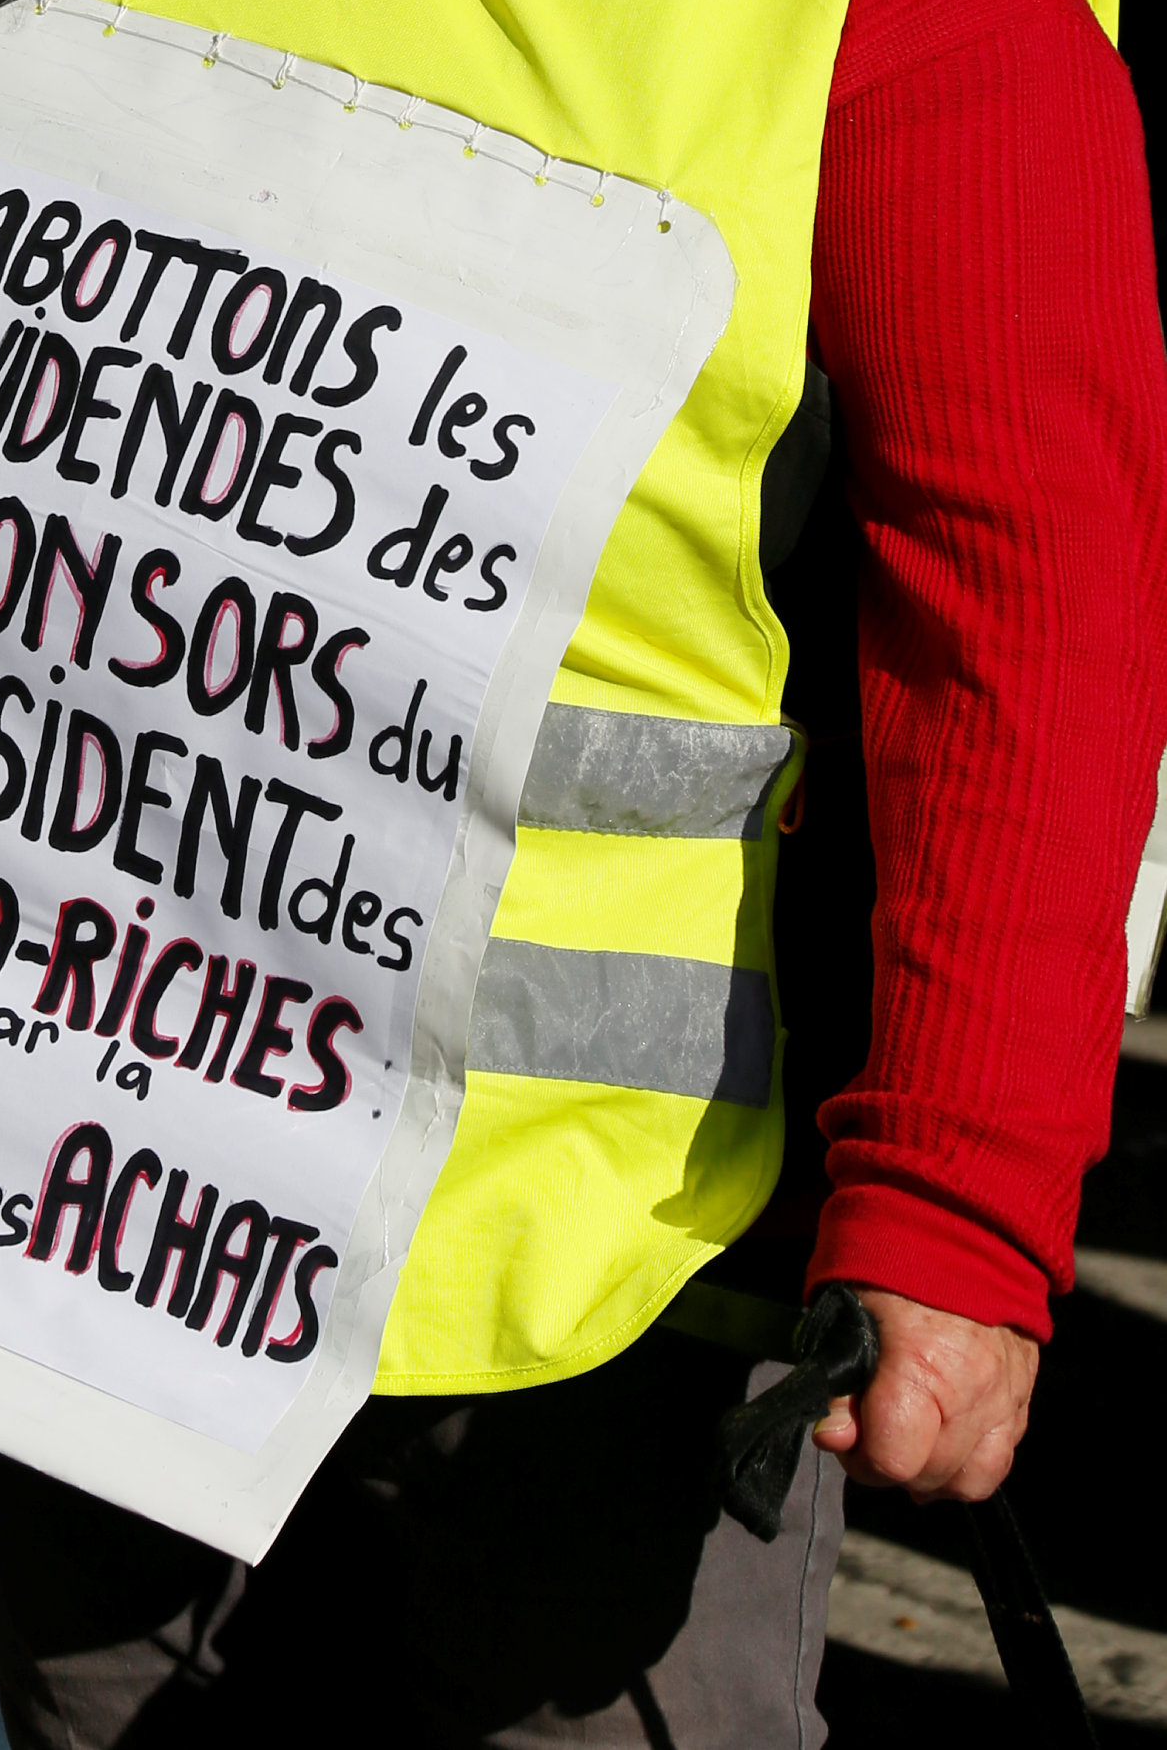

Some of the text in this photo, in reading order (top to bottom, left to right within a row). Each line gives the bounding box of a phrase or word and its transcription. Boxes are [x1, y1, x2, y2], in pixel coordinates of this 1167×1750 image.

[408, 344, 536, 481] les
[366, 483, 517, 612] des
[368, 678, 464, 803] du
[287, 833, 424, 972] des
[96, 1039, 153, 1102] la
[22, 1120, 339, 1364] ACHATS
